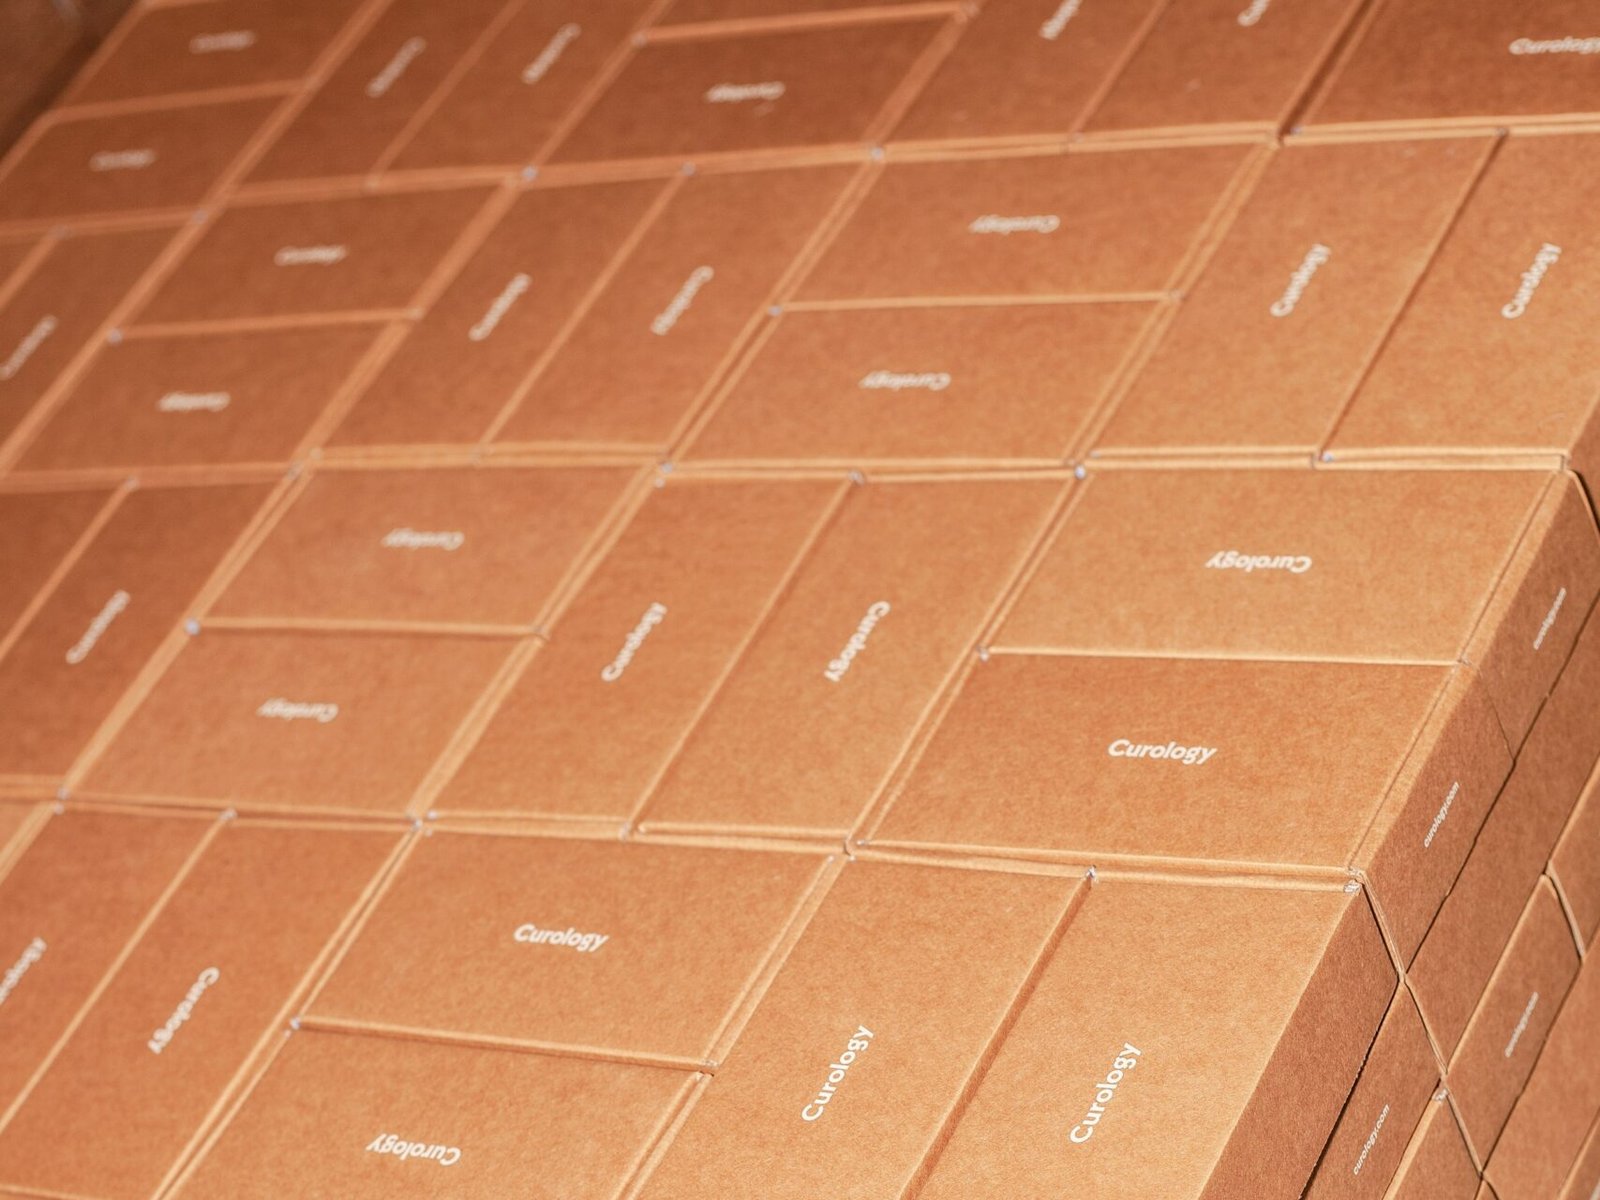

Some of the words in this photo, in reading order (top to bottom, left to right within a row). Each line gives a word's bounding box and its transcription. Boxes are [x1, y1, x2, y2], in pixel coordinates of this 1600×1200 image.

[1206, 551, 1311, 573] Curology
[1108, 739, 1216, 764] Curology
[514, 923, 608, 952] Curology
[148, 967, 220, 1054] Curology
[801, 1025, 874, 1121] Curology
[1069, 1043, 1141, 1143] Curology
[367, 1134, 461, 1166] Curology
[1353, 1104, 1389, 1175] curology.com
